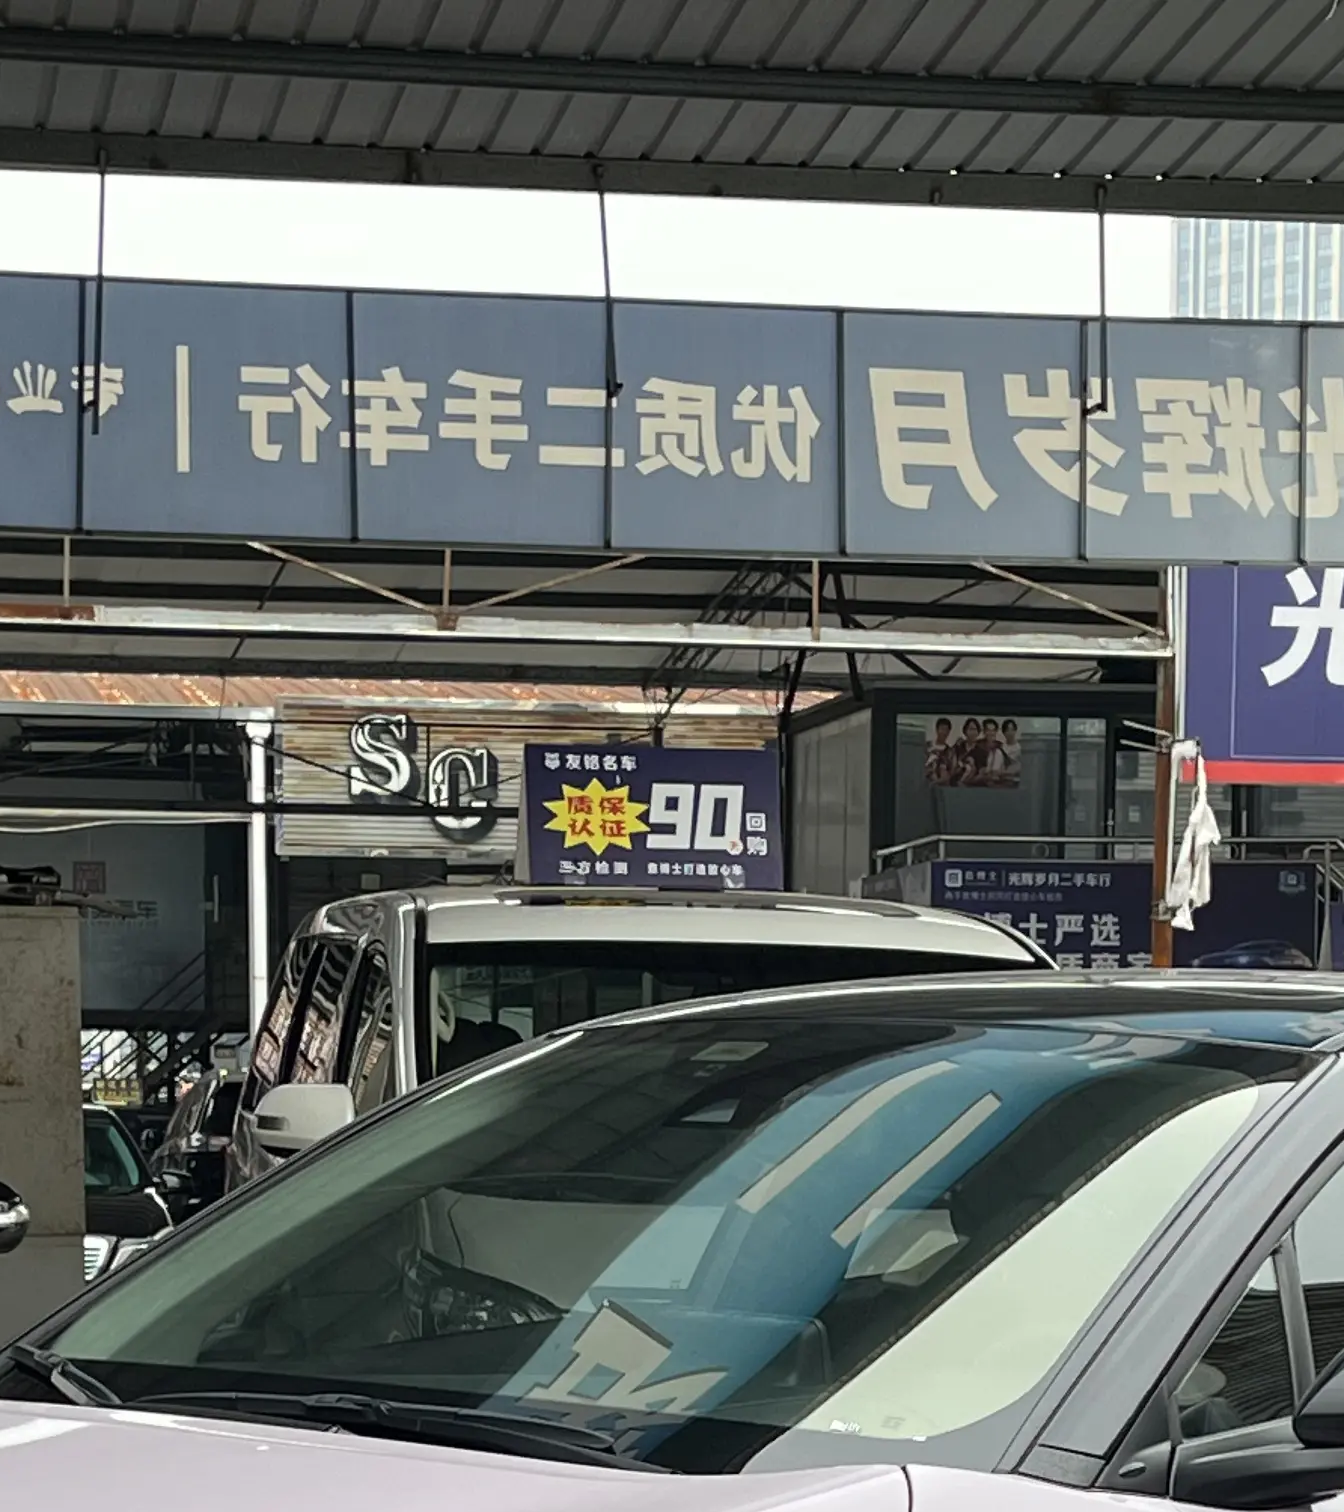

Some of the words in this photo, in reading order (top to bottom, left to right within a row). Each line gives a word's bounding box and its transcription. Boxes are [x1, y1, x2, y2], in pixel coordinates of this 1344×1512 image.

[567, 795, 627, 815] 质保
[646, 782, 744, 850] 90
[567, 818, 627, 838] 认证
